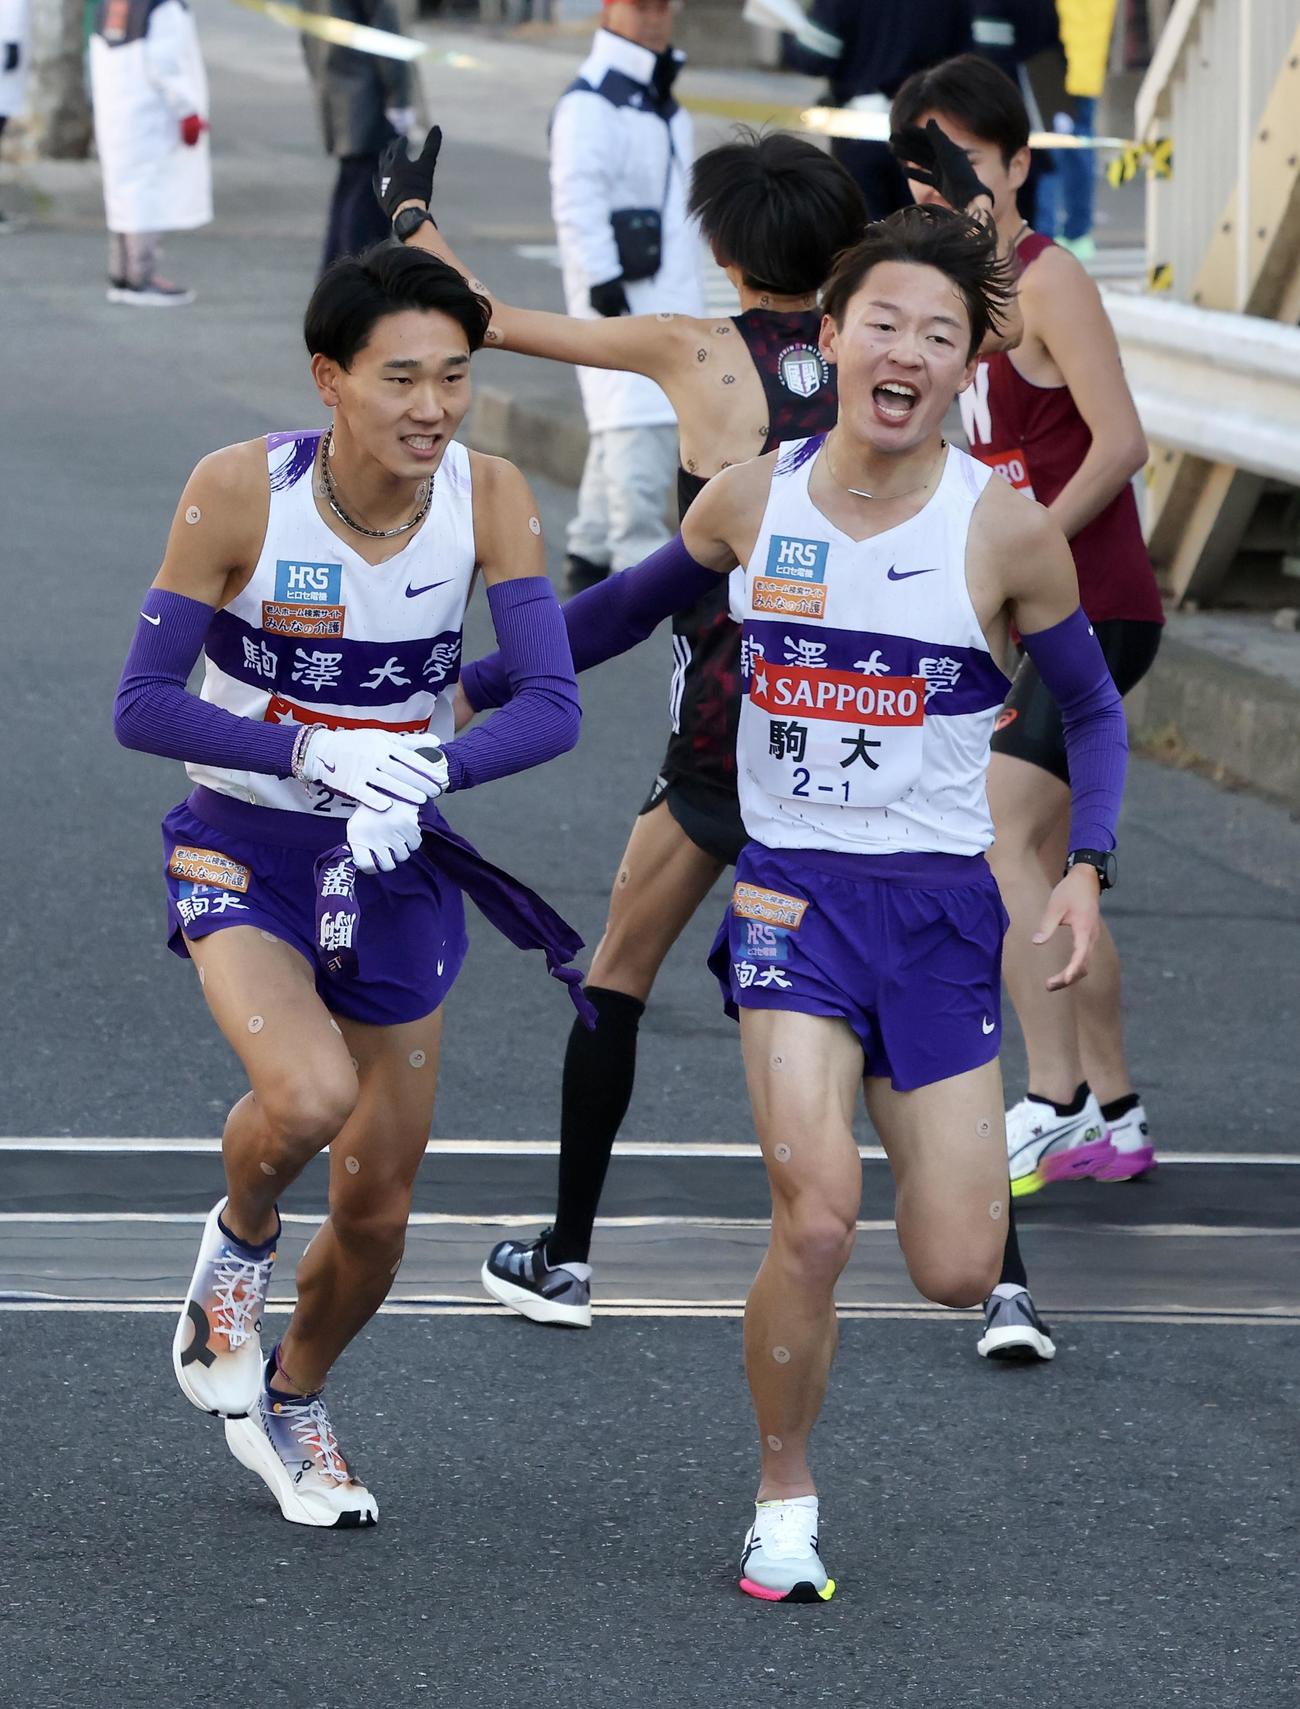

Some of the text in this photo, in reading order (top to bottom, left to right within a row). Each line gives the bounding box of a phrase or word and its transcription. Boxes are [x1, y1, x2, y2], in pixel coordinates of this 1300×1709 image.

[777, 540, 818, 567] HRS
[287, 565, 330, 590] HRS
[264, 604, 342, 620] 老人ホーム検索サイト
[754, 593, 823, 616] みんなの介護
[264, 616, 341, 636] みんなの介護
[774, 678, 918, 717] SAPPORO
[768, 719, 882, 771] 駒大
[792, 767, 850, 802] 2-1
[313, 788, 357, 812] 2-
[171, 861, 247, 889] みんなの介護
[176, 892, 250, 927] 駒大
[746, 922, 777, 945] HRS
